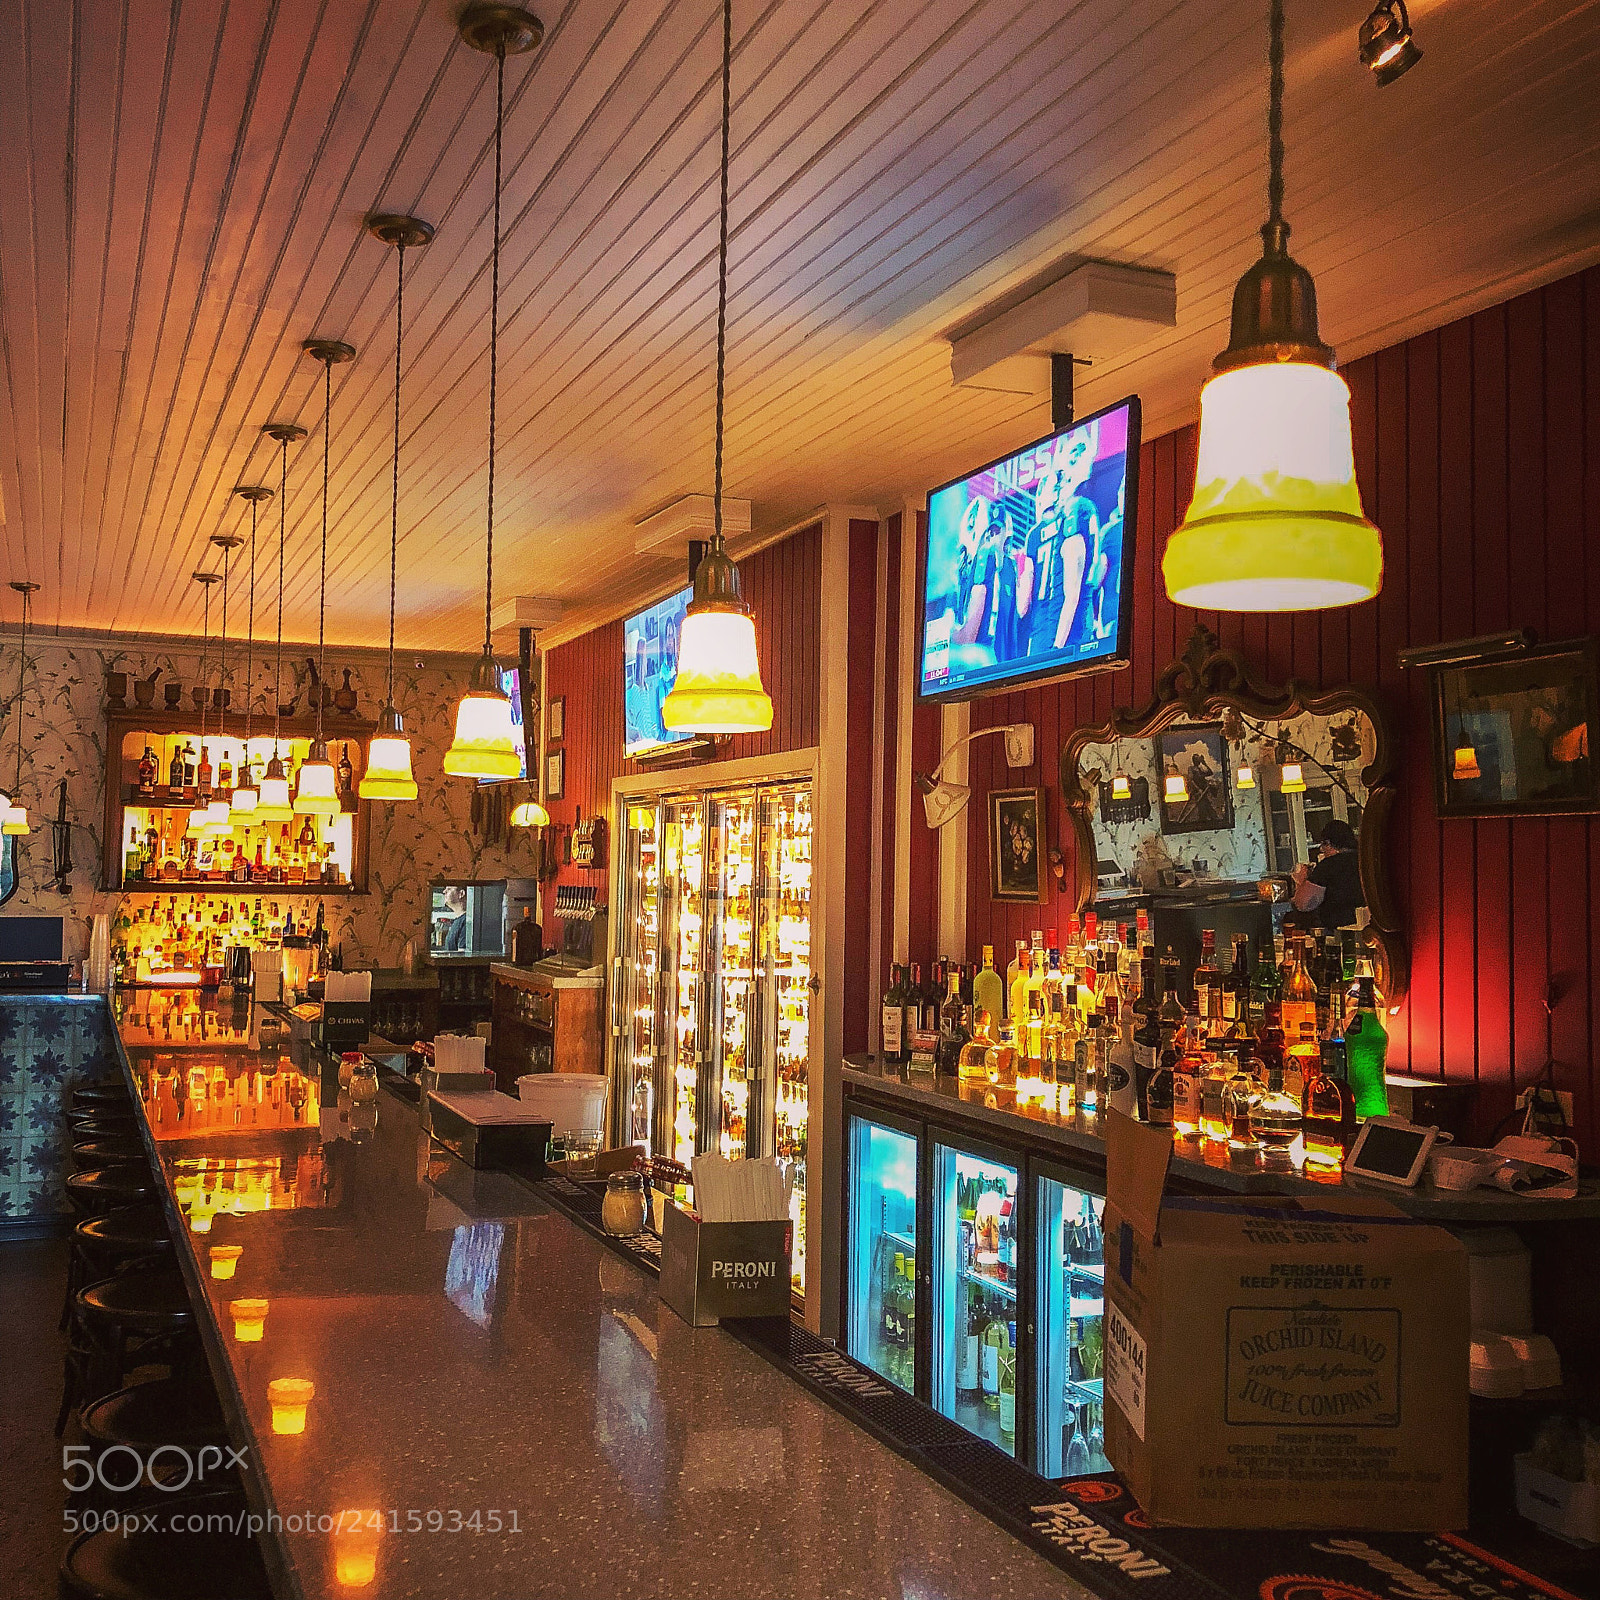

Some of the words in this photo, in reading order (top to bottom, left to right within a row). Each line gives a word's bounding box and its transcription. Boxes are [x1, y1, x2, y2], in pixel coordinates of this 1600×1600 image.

[337, 1017, 365, 1025] CHIVAS
[1241, 1229, 1290, 1244] THIS
[1293, 1231, 1341, 1244] SIDE
[1342, 1231, 1370, 1244] UP
[711, 1260, 777, 1279] PERONI
[1269, 1263, 1365, 1277] PERISHABLE
[726, 1281, 759, 1290] ITALY
[1239, 1275, 1281, 1289] KEEP
[1284, 1277, 1344, 1290] FROZEN
[1347, 1278, 1367, 1290] AT
[1110, 1314, 1144, 1376] 400144
[1239, 1326, 1314, 1361] ORCHID
[1319, 1327, 1388, 1363] ISLAND
[1238, 1378, 1294, 1414] JUICE
[1298, 1380, 1383, 1417] COMPANY
[1276, 1433, 1313, 1444] FRESH
[1315, 1434, 1358, 1444] FROZEN
[1227, 1444, 1269, 1455] ORCHID
[1271, 1445, 1311, 1455] ISLAND
[1346, 1446, 1398, 1457] COMPANY
[1030, 1502, 1172, 1579] PERONI
[1031, 1521, 1103, 1562] ITALY
